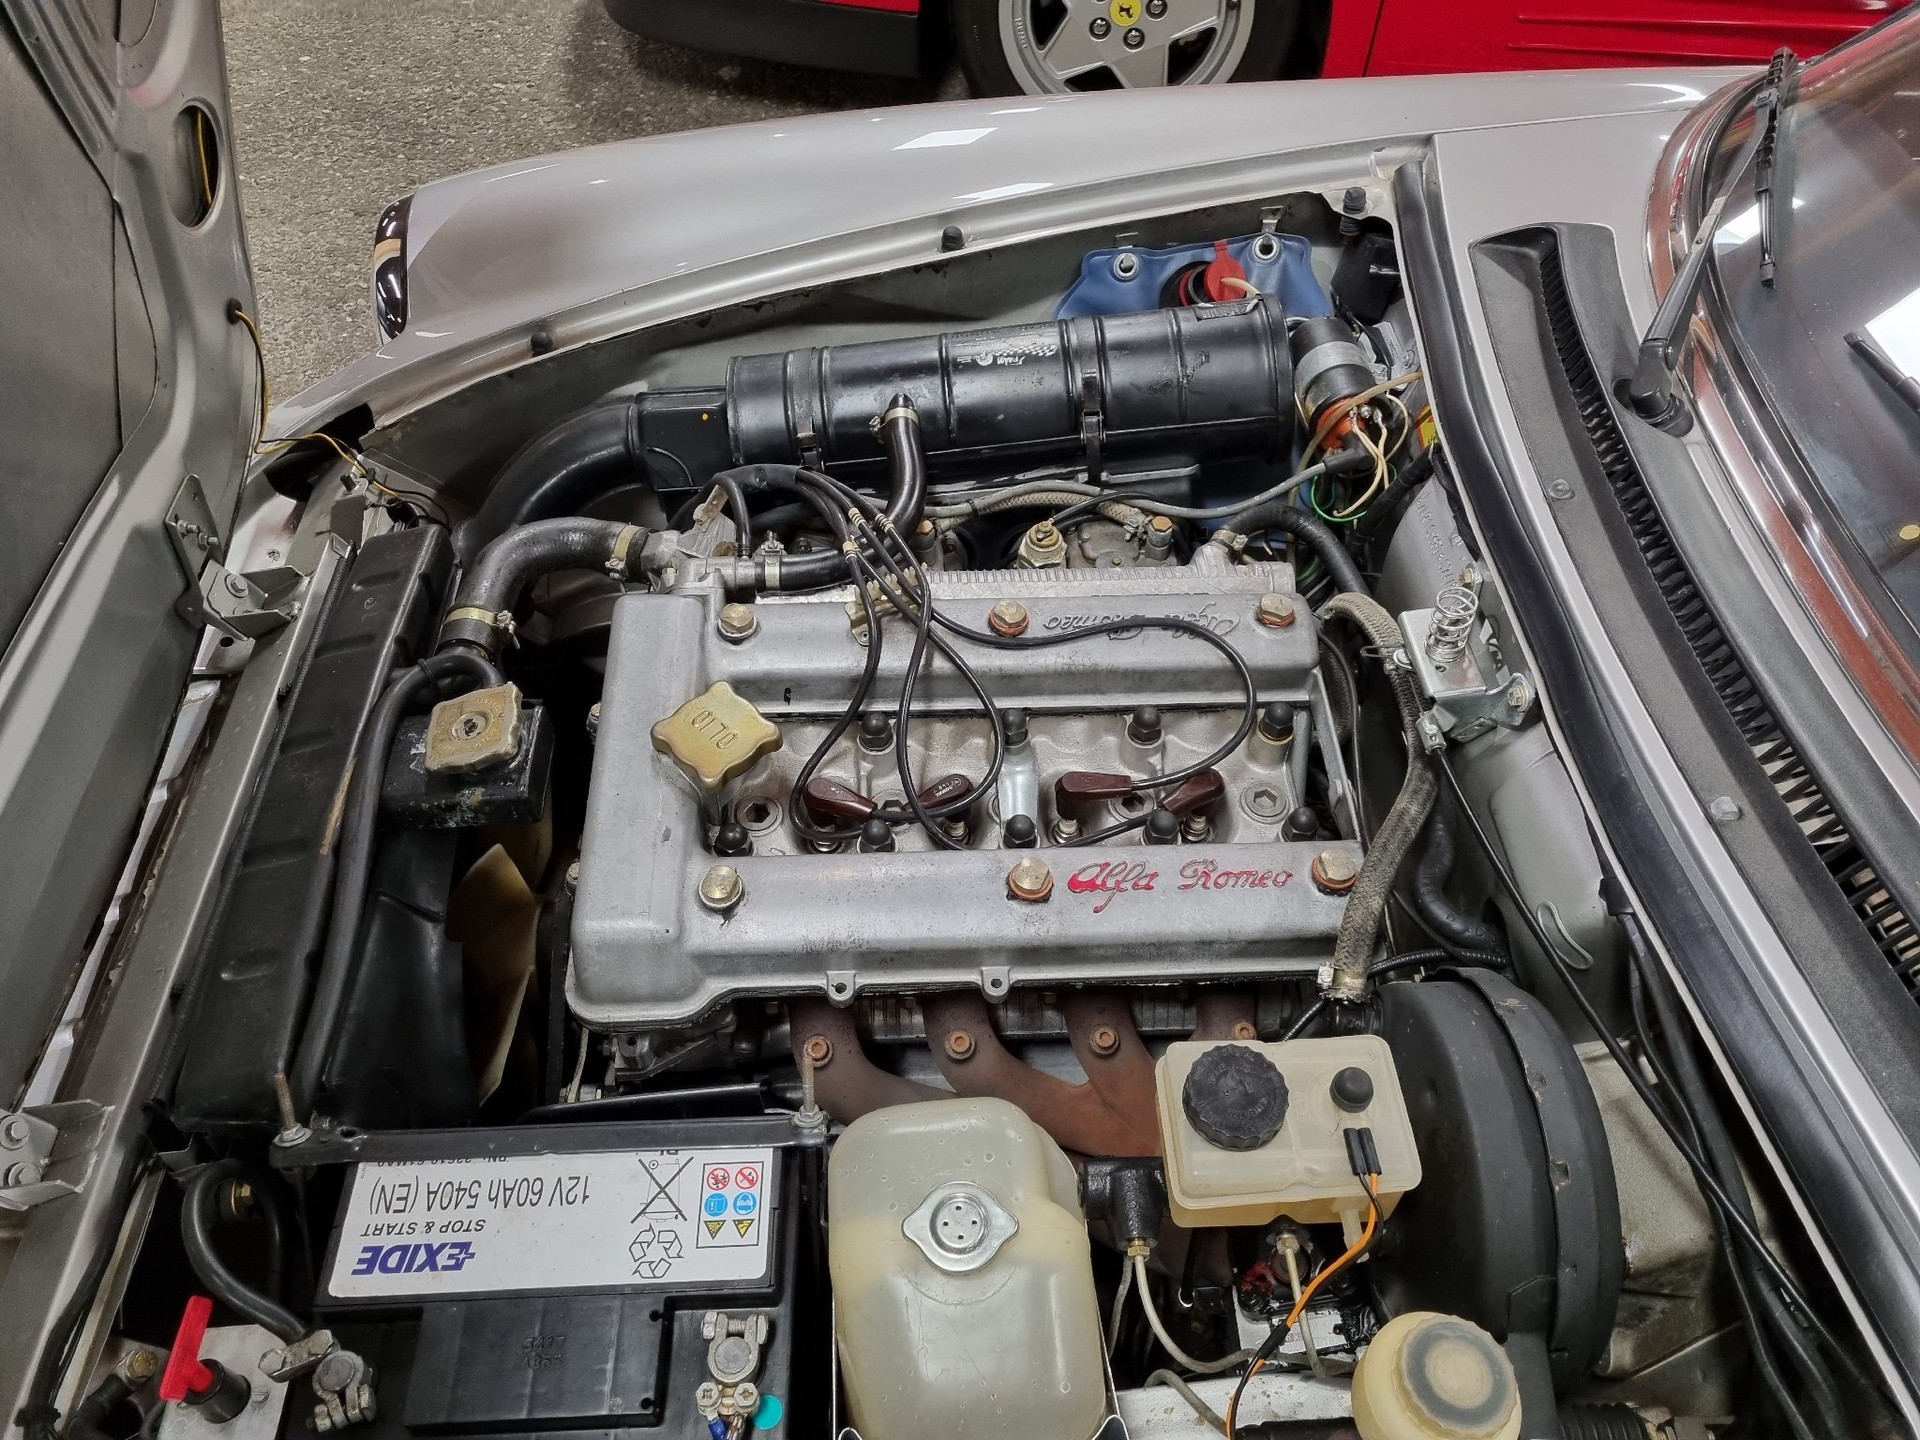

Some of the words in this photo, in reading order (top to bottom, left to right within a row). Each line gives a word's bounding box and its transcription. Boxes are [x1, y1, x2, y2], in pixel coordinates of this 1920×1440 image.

[691, 709, 740, 750] OLIO
[1066, 860, 1160, 914] Alfa
[1177, 858, 1294, 891] Romeo
[369, 1175, 419, 1216] (EN)
[426, 1180, 482, 1213] 540A
[488, 1177, 544, 1210] 60Ah
[548, 1175, 590, 1207] 12V
[359, 1221, 419, 1237] START
[424, 1221, 436, 1235] &
[438, 1218, 487, 1234] STOP
[350, 1240, 477, 1276] EXIDE
